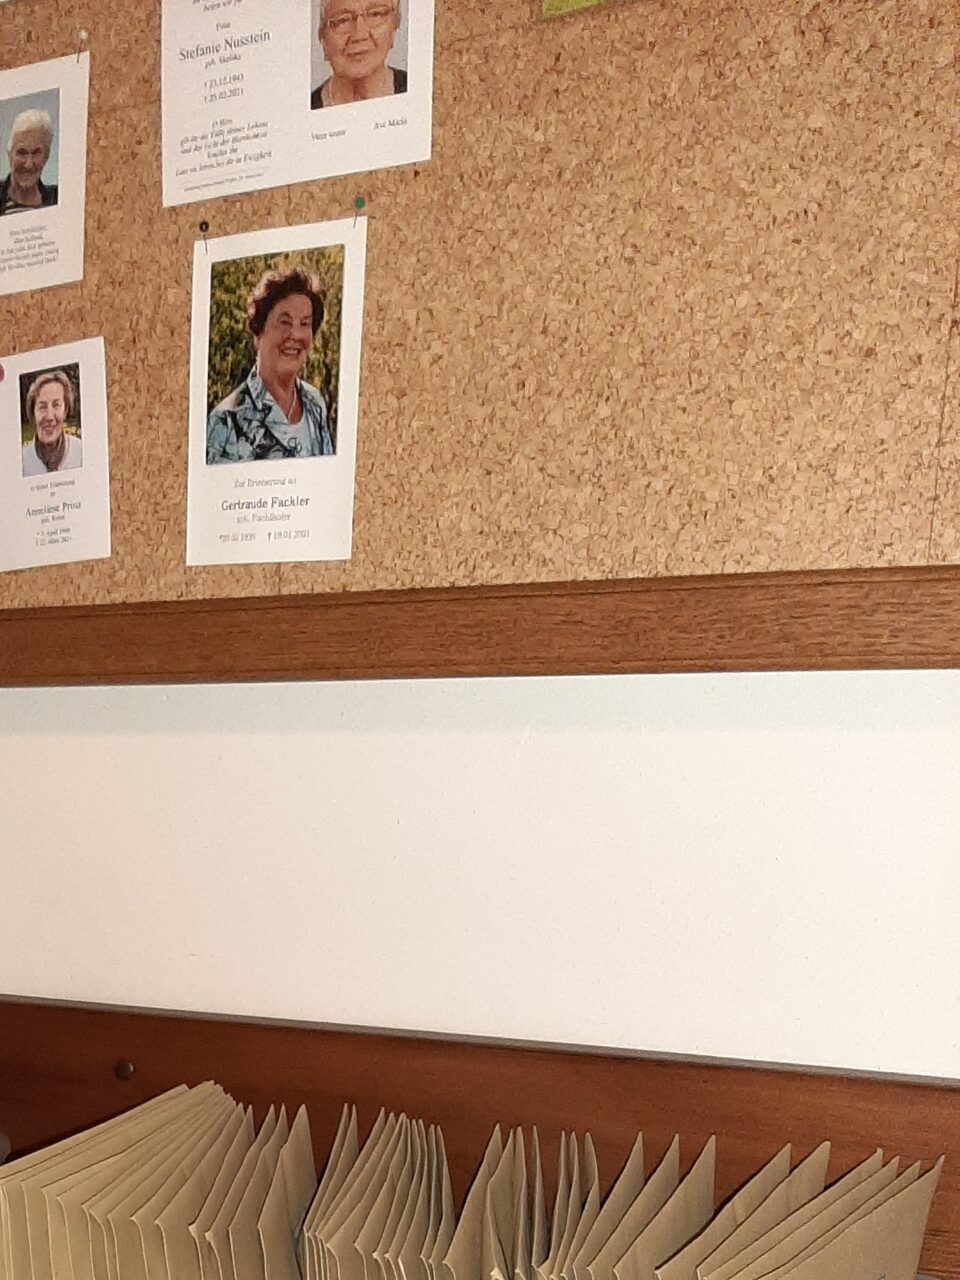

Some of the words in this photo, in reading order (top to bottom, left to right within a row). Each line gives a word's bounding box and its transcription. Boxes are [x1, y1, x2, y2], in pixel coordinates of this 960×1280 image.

[179, 43, 221, 60] Stefanie
[224, 29, 271, 50] Nusstein
[221, 498, 268, 511] Gertraude
[271, 496, 311, 508] Fackler
